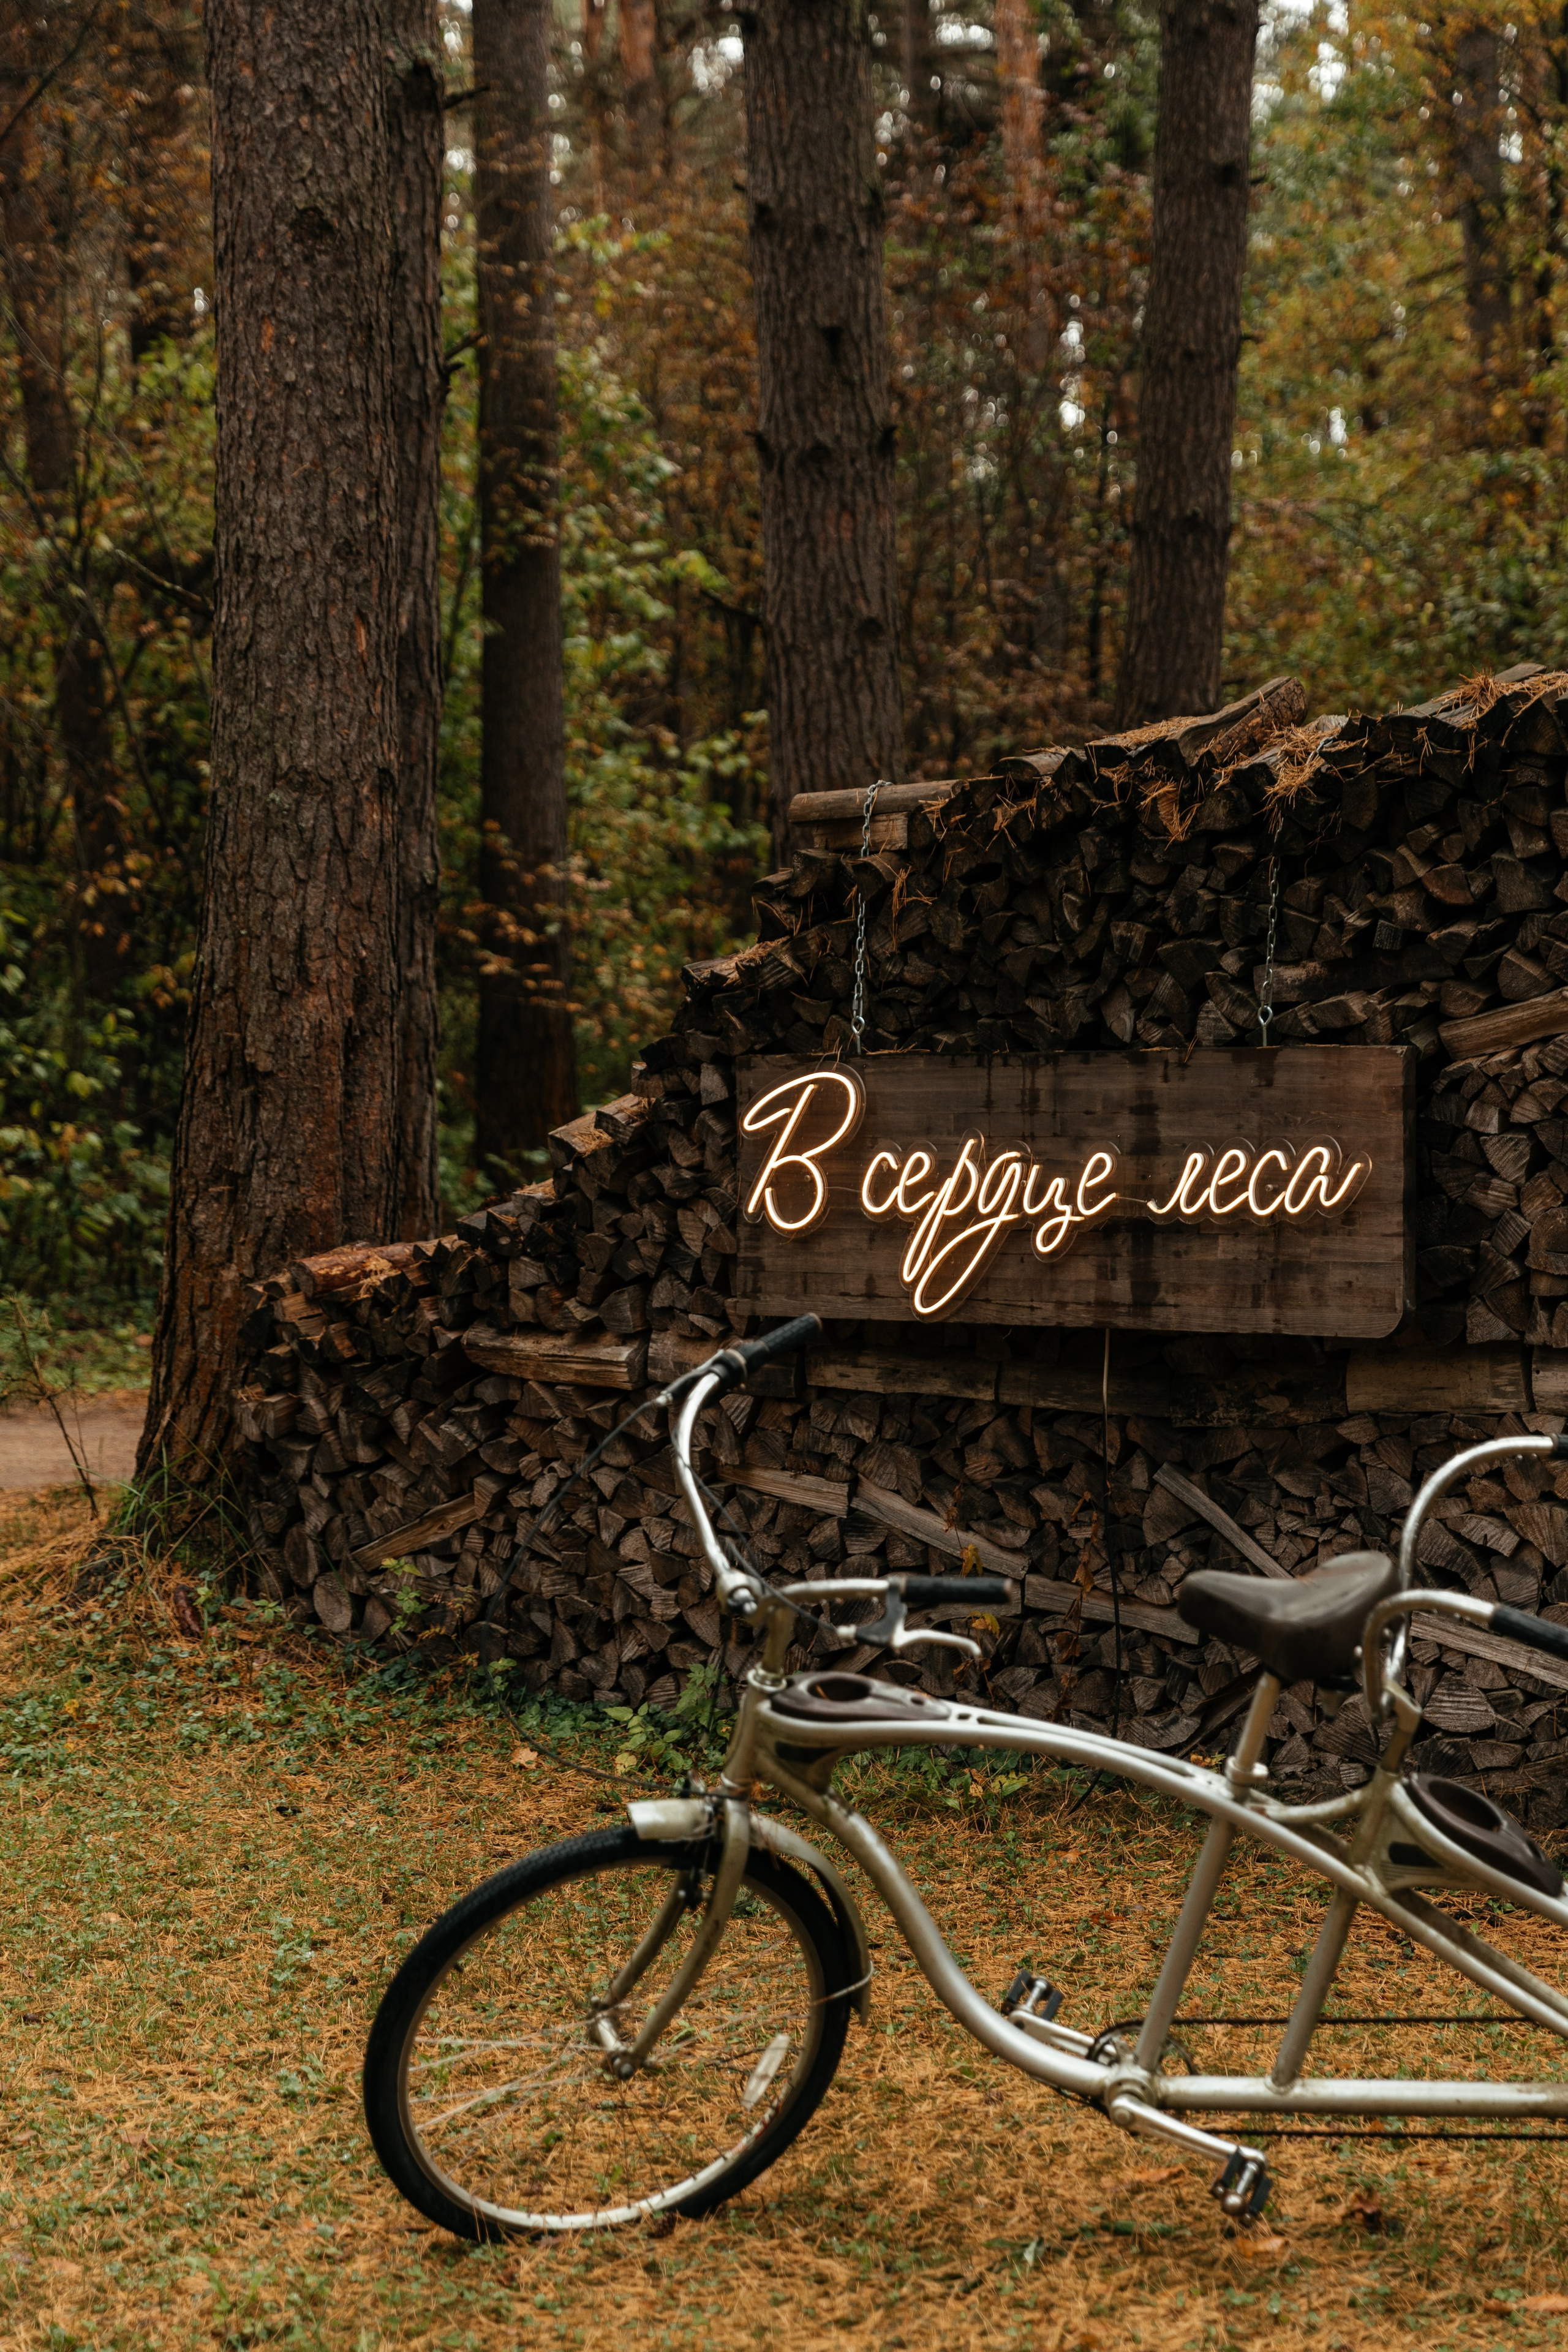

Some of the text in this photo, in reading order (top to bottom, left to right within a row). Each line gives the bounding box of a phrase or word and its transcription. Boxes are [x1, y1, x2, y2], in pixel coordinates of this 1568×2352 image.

[742, 1071, 1363, 1314] В сердце леса
